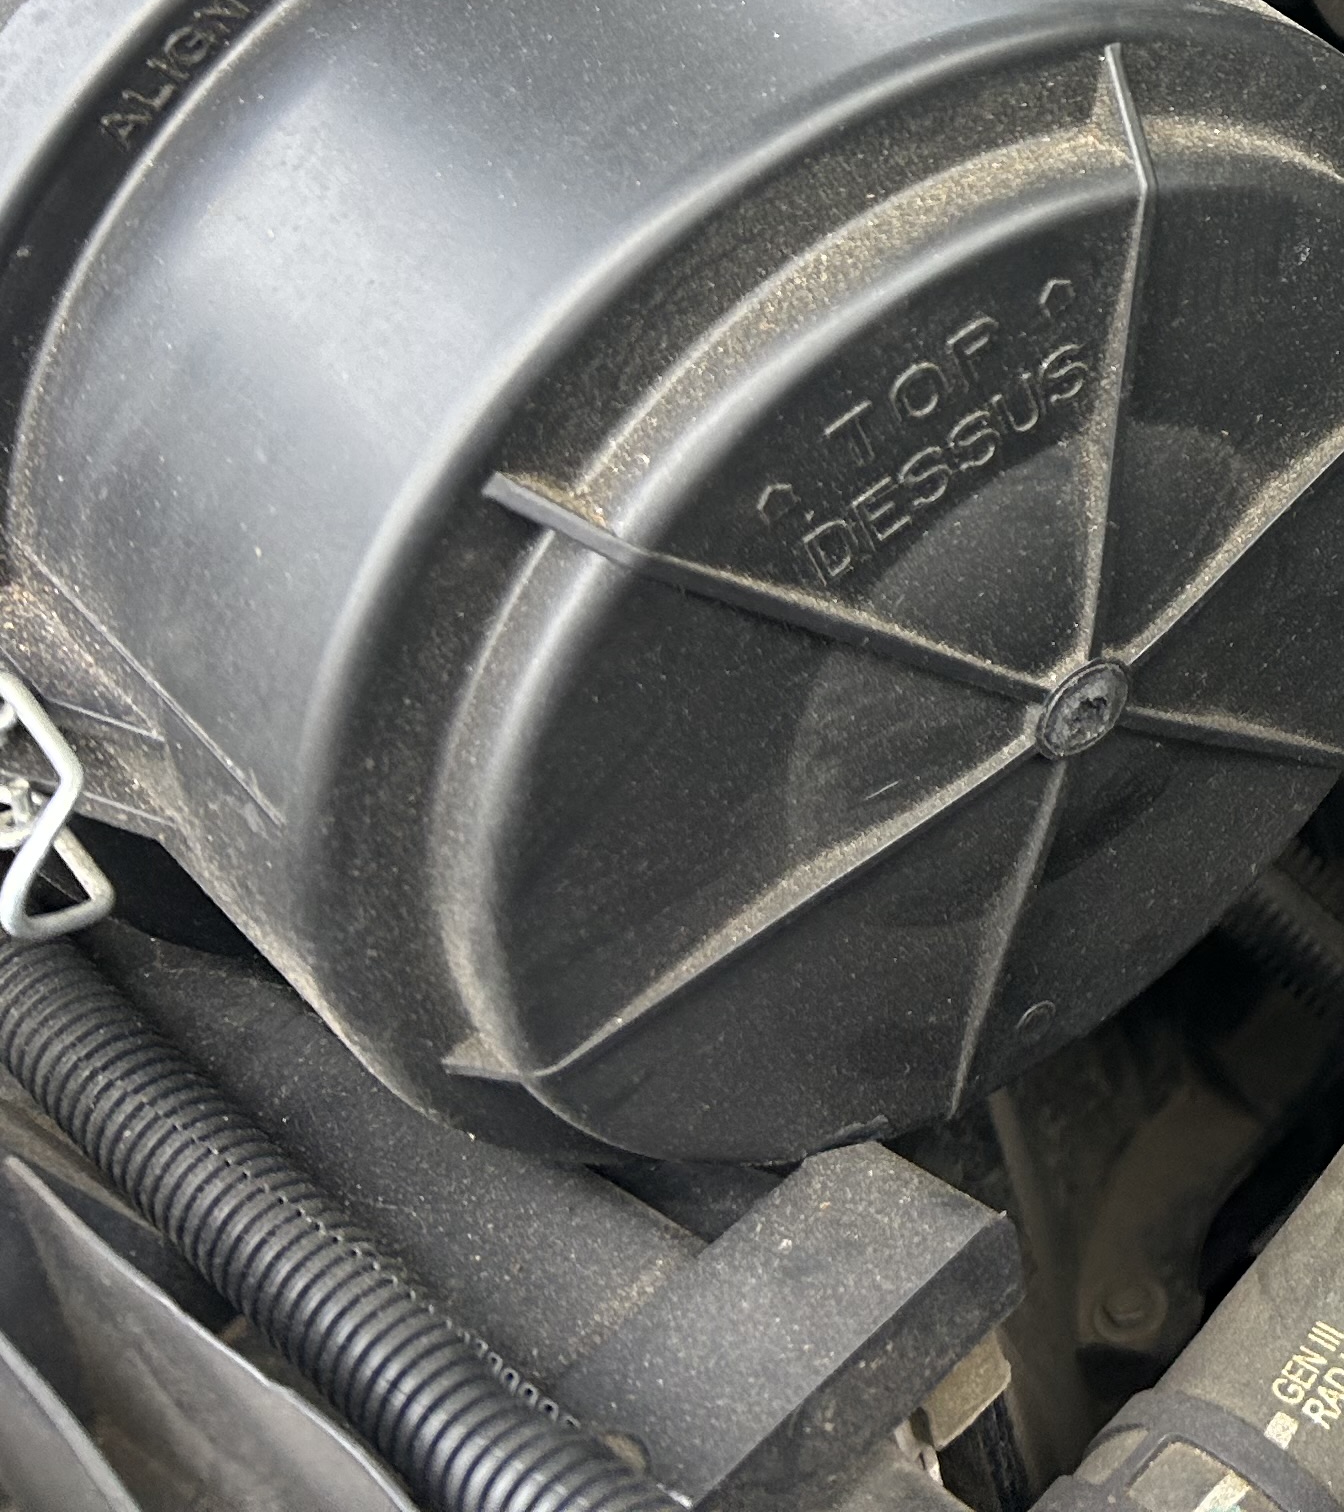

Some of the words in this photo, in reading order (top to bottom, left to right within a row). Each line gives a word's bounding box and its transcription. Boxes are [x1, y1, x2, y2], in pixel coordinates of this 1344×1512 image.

[802, 343, 1088, 586] DESSUS
[823, 315, 999, 467] TOP
[1271, 1345, 1328, 1405] GEN
[1308, 1320, 1344, 1352] III
